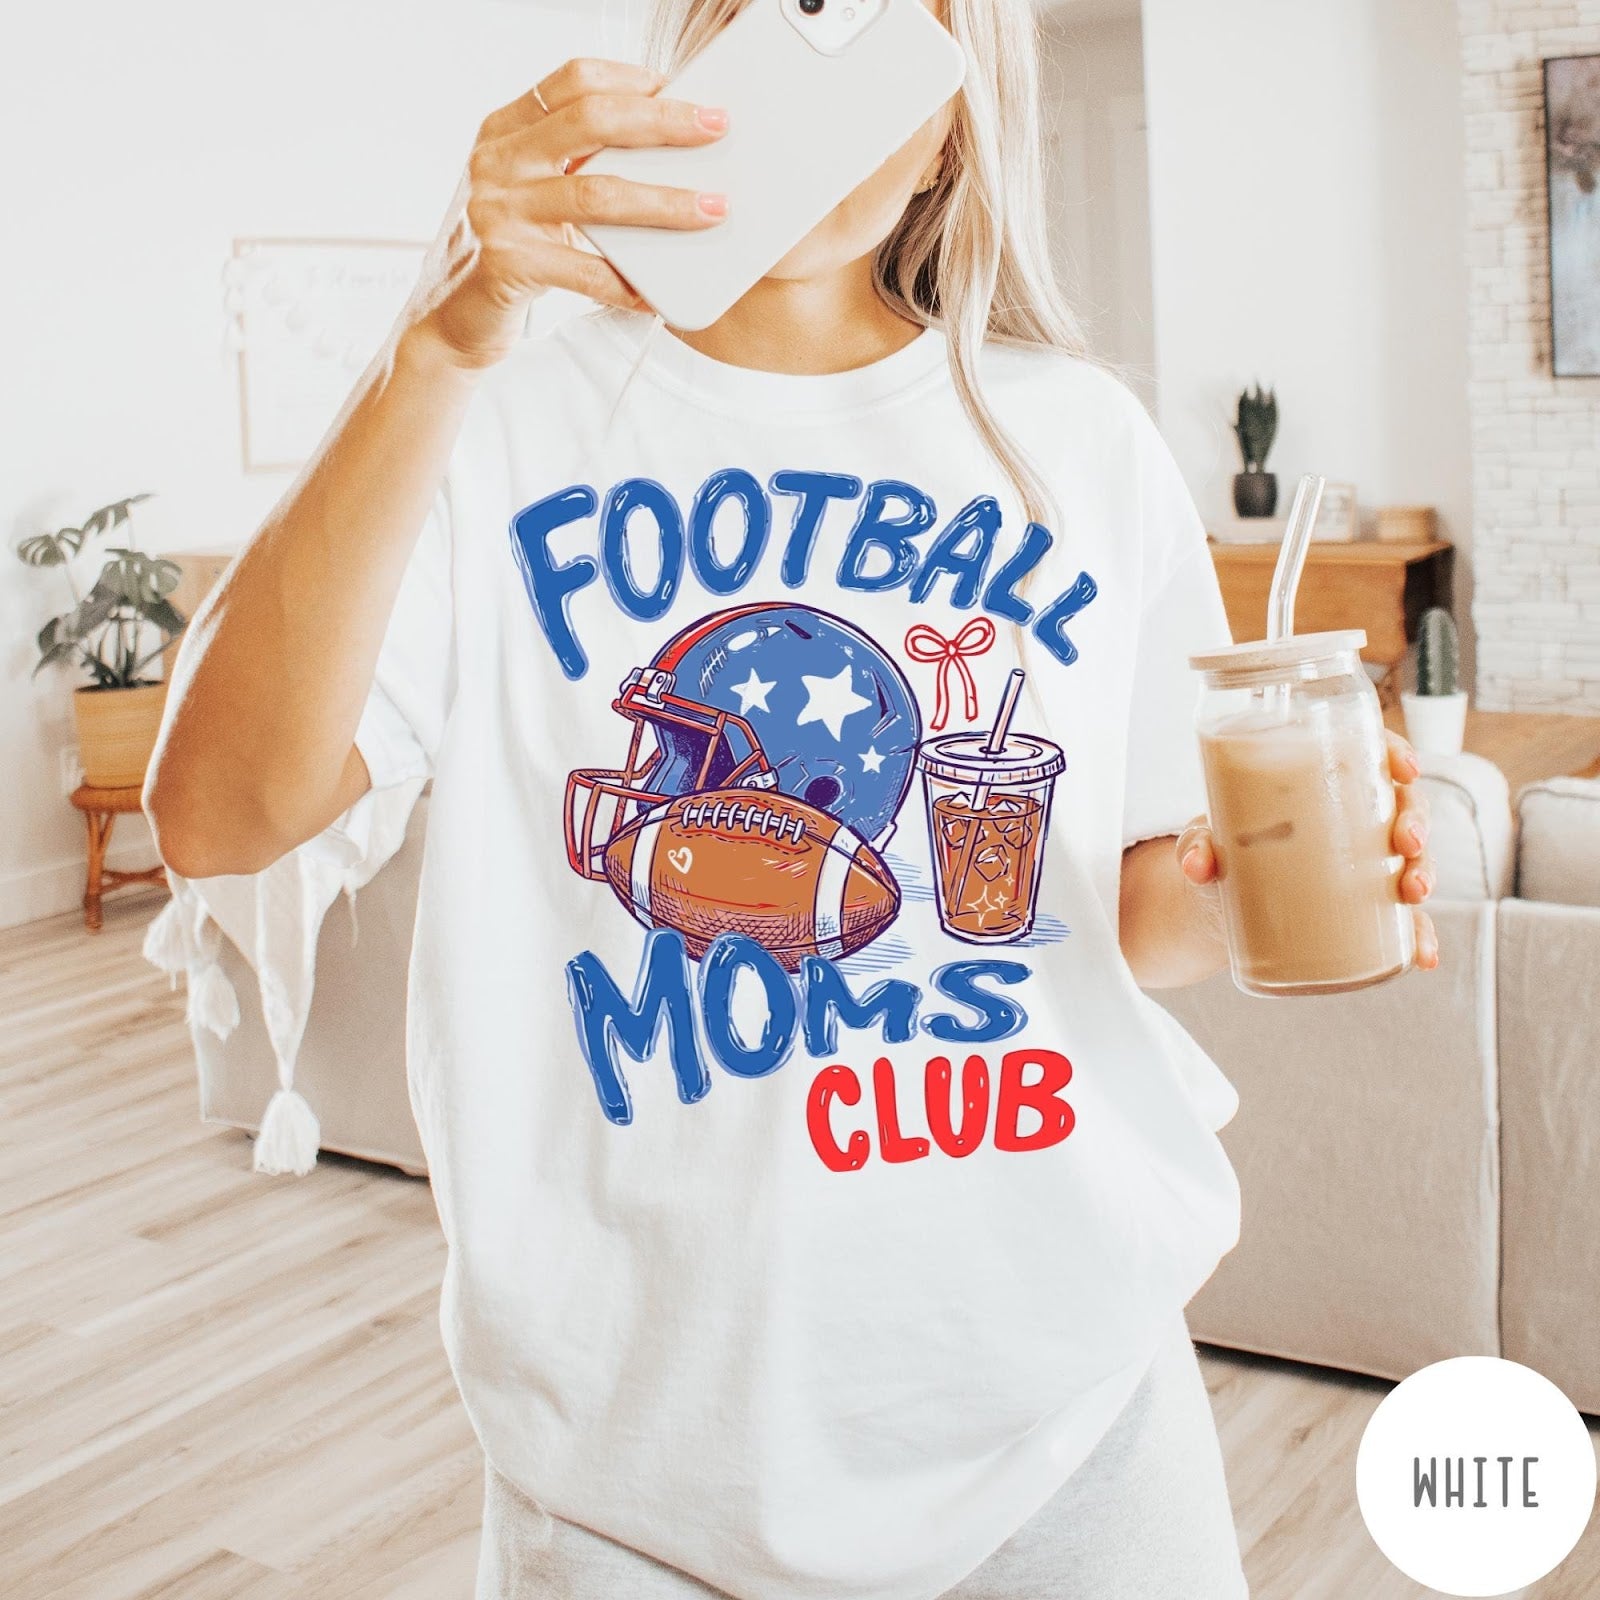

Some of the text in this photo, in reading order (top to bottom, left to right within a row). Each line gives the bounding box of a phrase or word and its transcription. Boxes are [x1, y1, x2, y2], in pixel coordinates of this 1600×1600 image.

[510, 468, 1099, 682] FOOTBALL
[565, 928, 1033, 1126] MOMS
[806, 1048, 1076, 1173] CLUB
